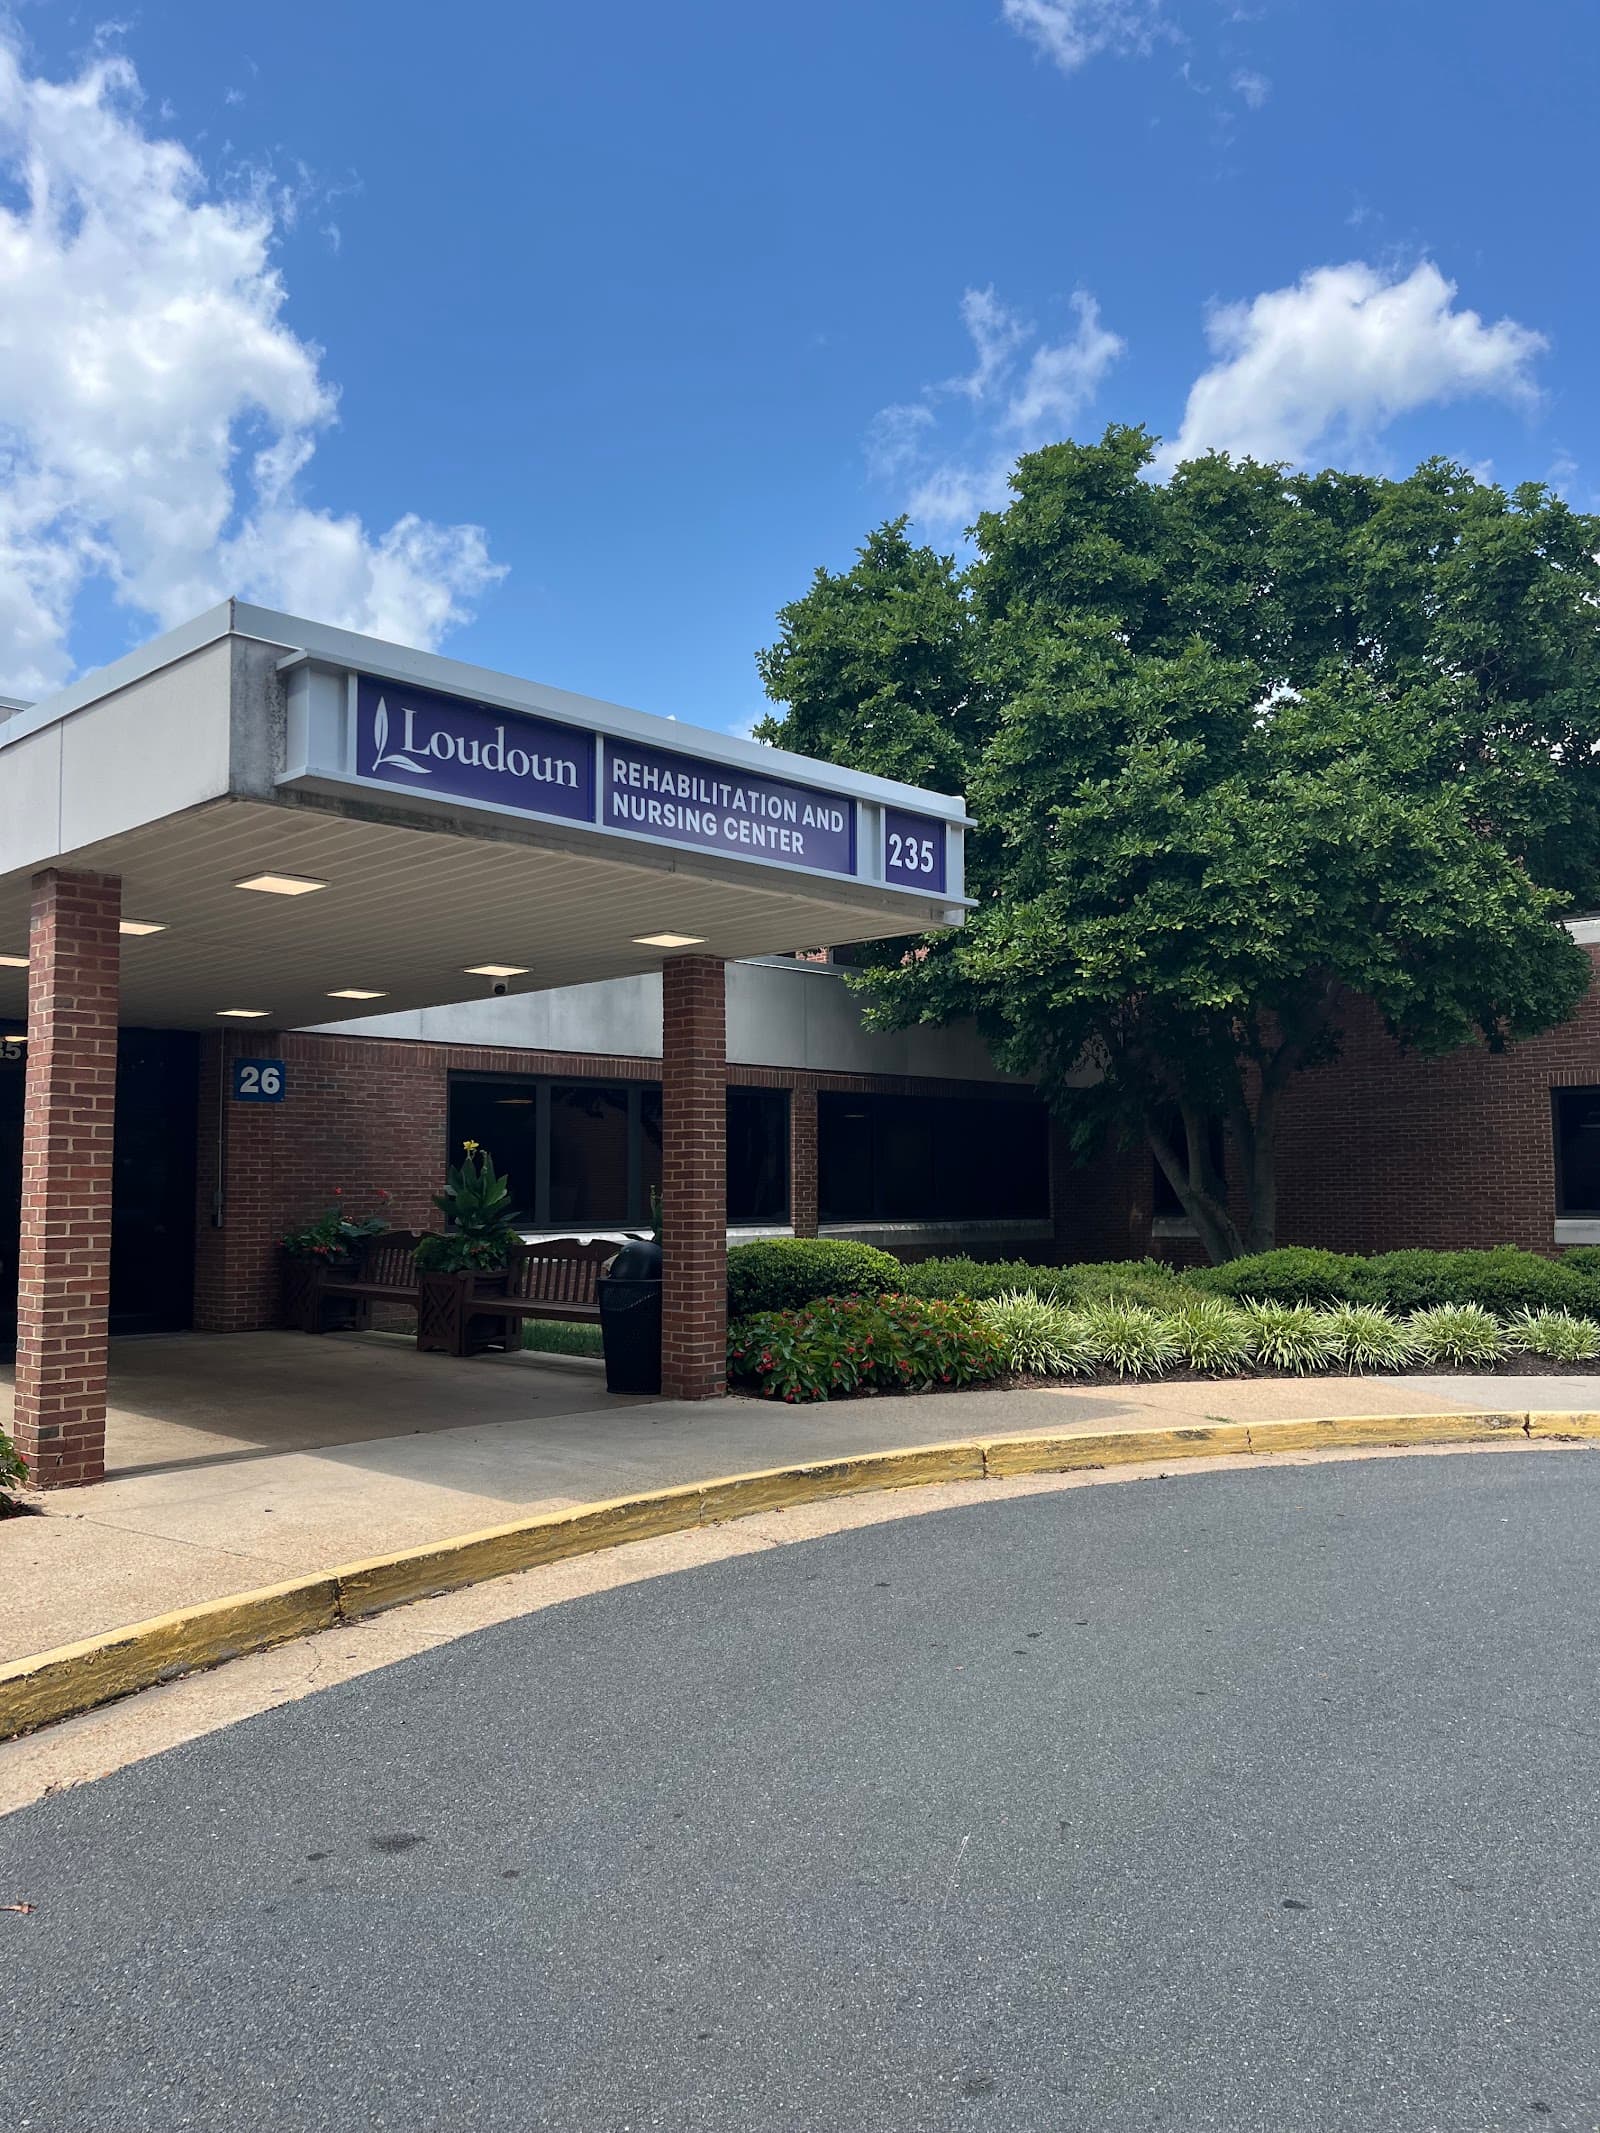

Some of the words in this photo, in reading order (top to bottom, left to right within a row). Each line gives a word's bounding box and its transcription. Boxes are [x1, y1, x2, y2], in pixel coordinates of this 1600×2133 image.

[401, 707, 579, 788] Loudoun
[612, 758, 797, 824] REHABILITATION
[801, 805, 844, 833] AND
[612, 791, 718, 837] NURSING
[723, 816, 804, 855] CENTER
[888, 833, 935, 873] 235
[239, 1066, 281, 1095] 26
